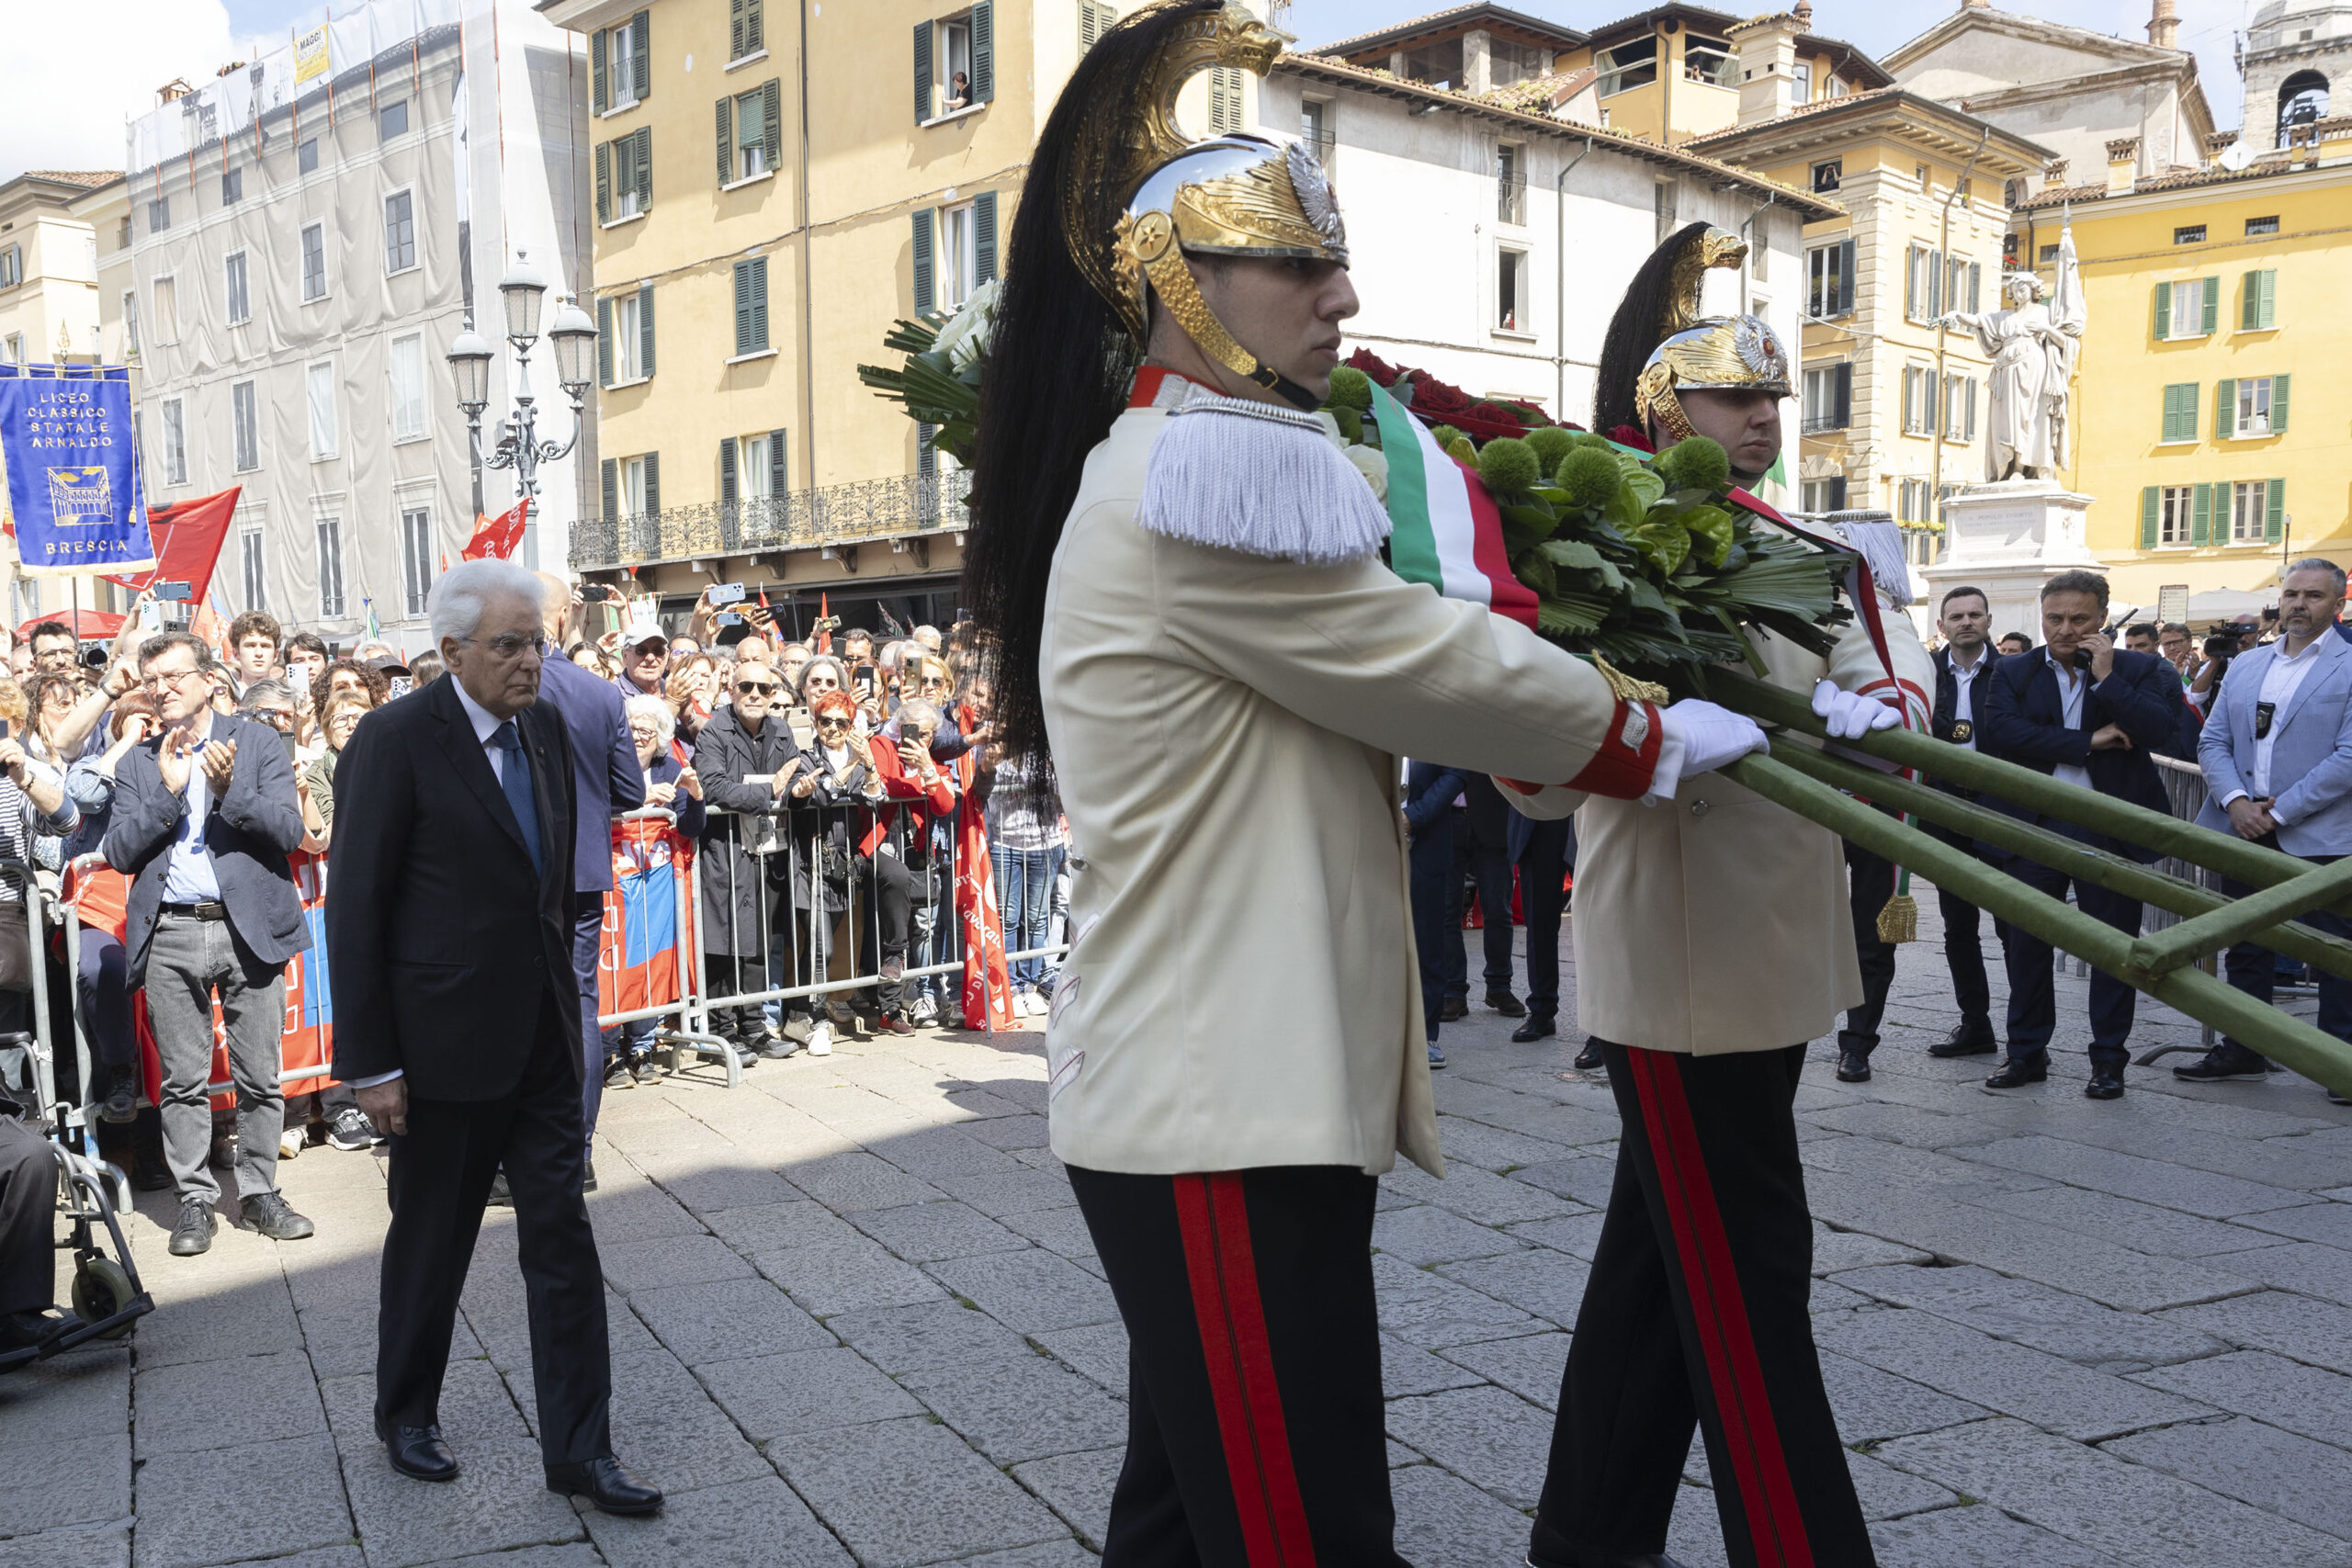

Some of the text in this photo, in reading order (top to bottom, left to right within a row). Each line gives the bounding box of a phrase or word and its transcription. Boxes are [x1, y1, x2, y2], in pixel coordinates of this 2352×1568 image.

[300, 30, 322, 51] MAGGI
[40, 392, 90, 404] LICEO
[28, 407, 107, 419] CLASSICO
[30, 422, 109, 434] STATALE
[32, 436, 112, 448] ARNALDO
[45, 539, 128, 555] BRESCIA
